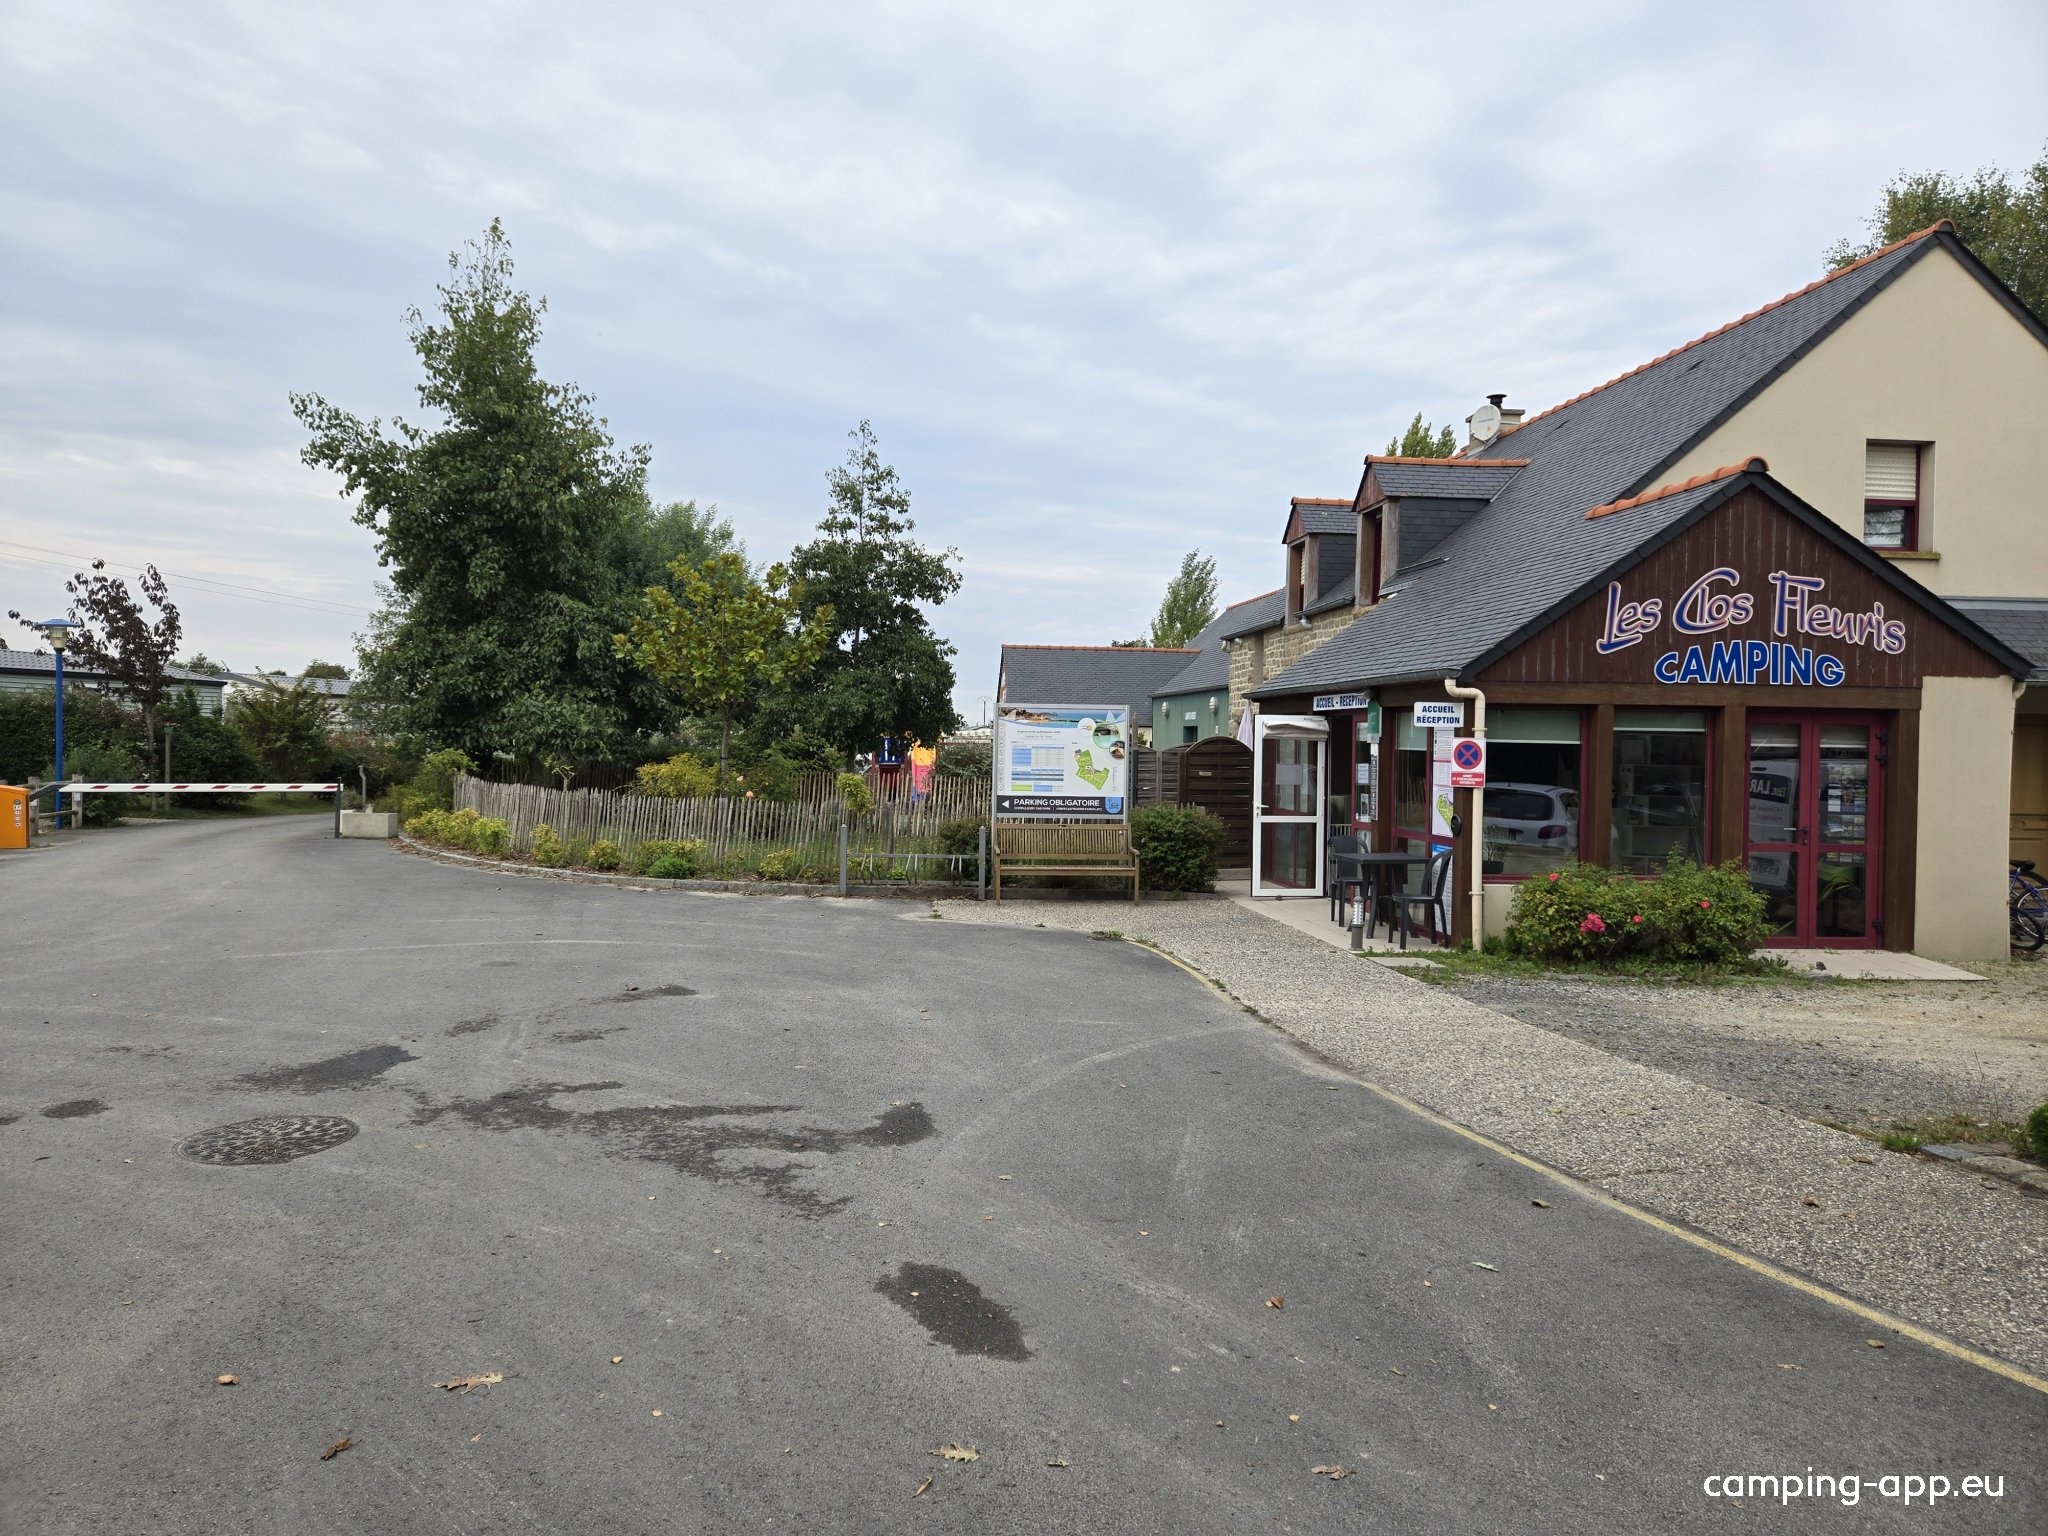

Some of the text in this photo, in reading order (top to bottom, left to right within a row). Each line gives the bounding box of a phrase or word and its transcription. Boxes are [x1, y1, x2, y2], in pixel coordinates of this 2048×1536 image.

[1596, 567, 1906, 655] Les Clos Fleuris
[1654, 640, 1845, 687] CAMPING
[1316, 697, 1335, 708] ACCUEIL
[1422, 705, 1455, 713] ACCUEIL
[1013, 798, 1100, 807] PARKING OBLIGATOIRE
